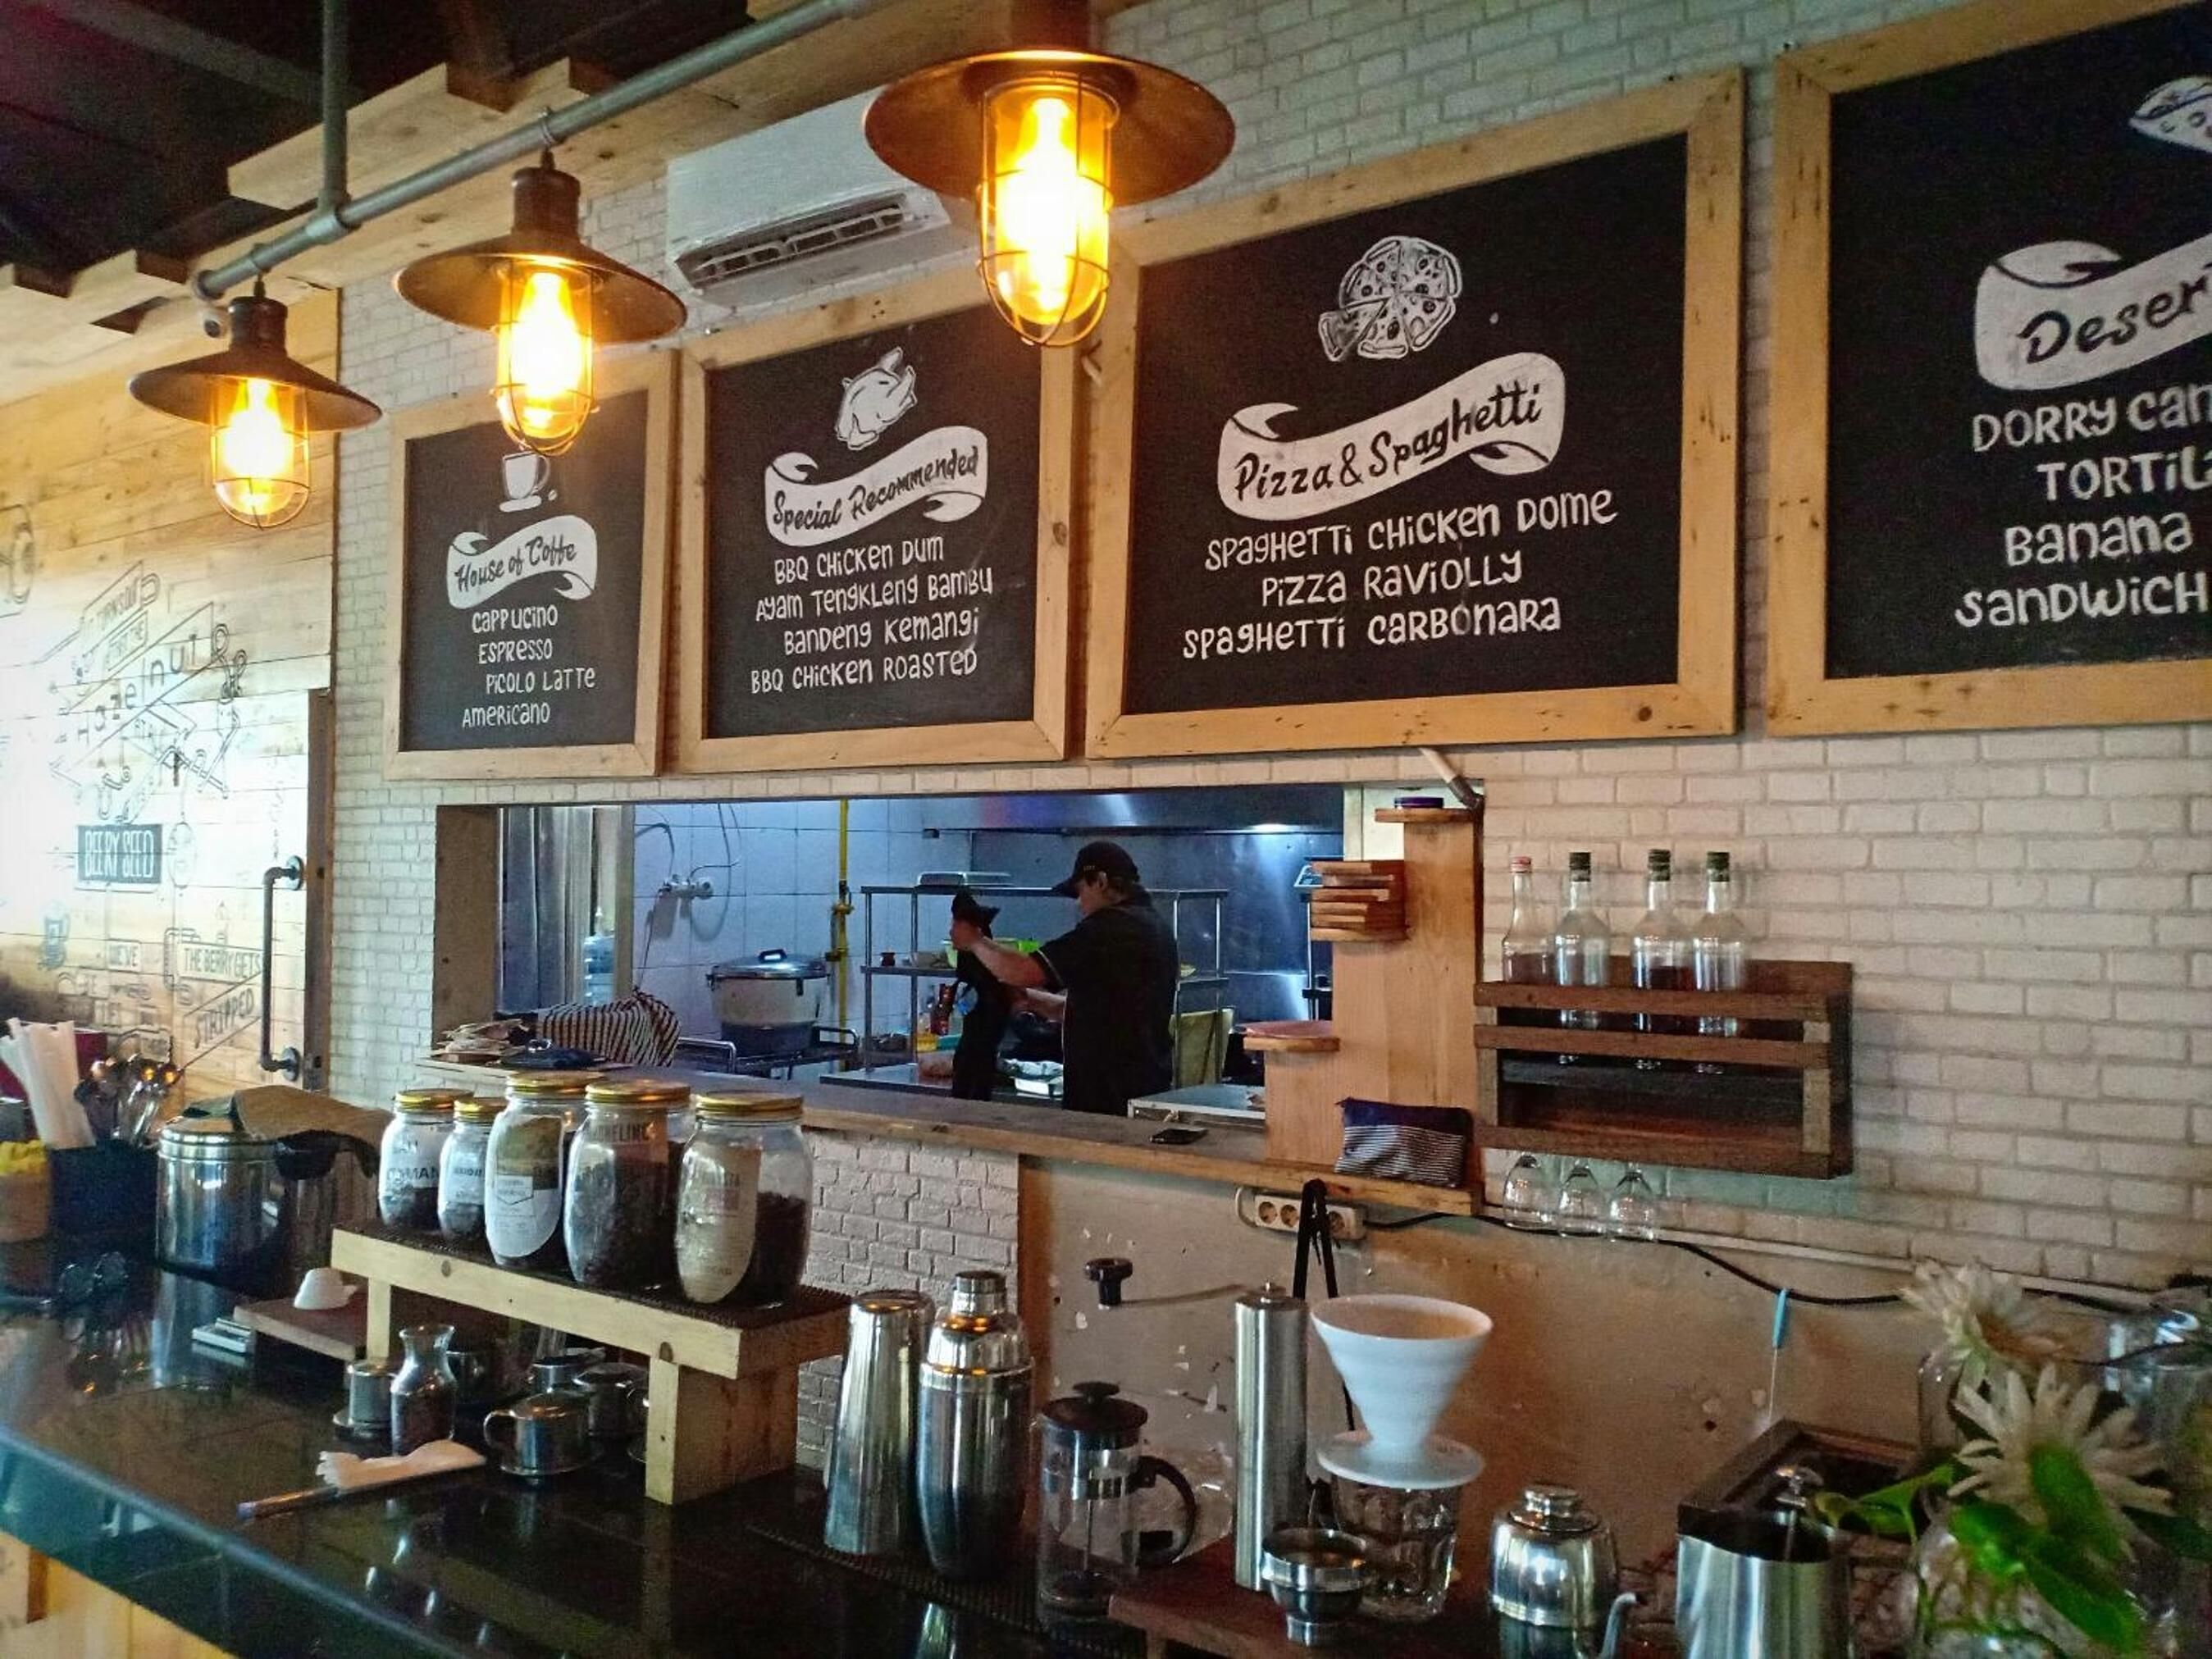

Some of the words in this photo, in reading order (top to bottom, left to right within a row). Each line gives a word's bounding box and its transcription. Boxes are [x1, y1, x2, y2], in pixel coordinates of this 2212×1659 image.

[2016, 261, 2212, 364] Deser
[1234, 453, 1333, 502] Pizza
[1369, 381, 1543, 476] Spaghetti
[773, 490, 841, 534] Special
[847, 445, 979, 520] Recommended
[1367, 501, 1501, 553] CHiCKen
[1516, 489, 1620, 533] DOme
[2004, 512, 2195, 567] Banana
[454, 559, 505, 591] House
[509, 547, 525, 576] of
[525, 535, 577, 567] Coffe
[774, 556, 809, 585] BBQ
[816, 544, 893, 578] CHiCKen
[1261, 571, 1348, 608] PiZZa
[884, 607, 980, 644] Kemangi
[486, 672, 536, 695] PiCOLO
[542, 667, 596, 691] LaTTe
[750, 668, 784, 695] BBQ
[792, 658, 873, 689] CHiCKen
[883, 648, 978, 682] ROasTeD
[122, 830, 154, 878] SEED
[185, 947, 203, 972] THE
